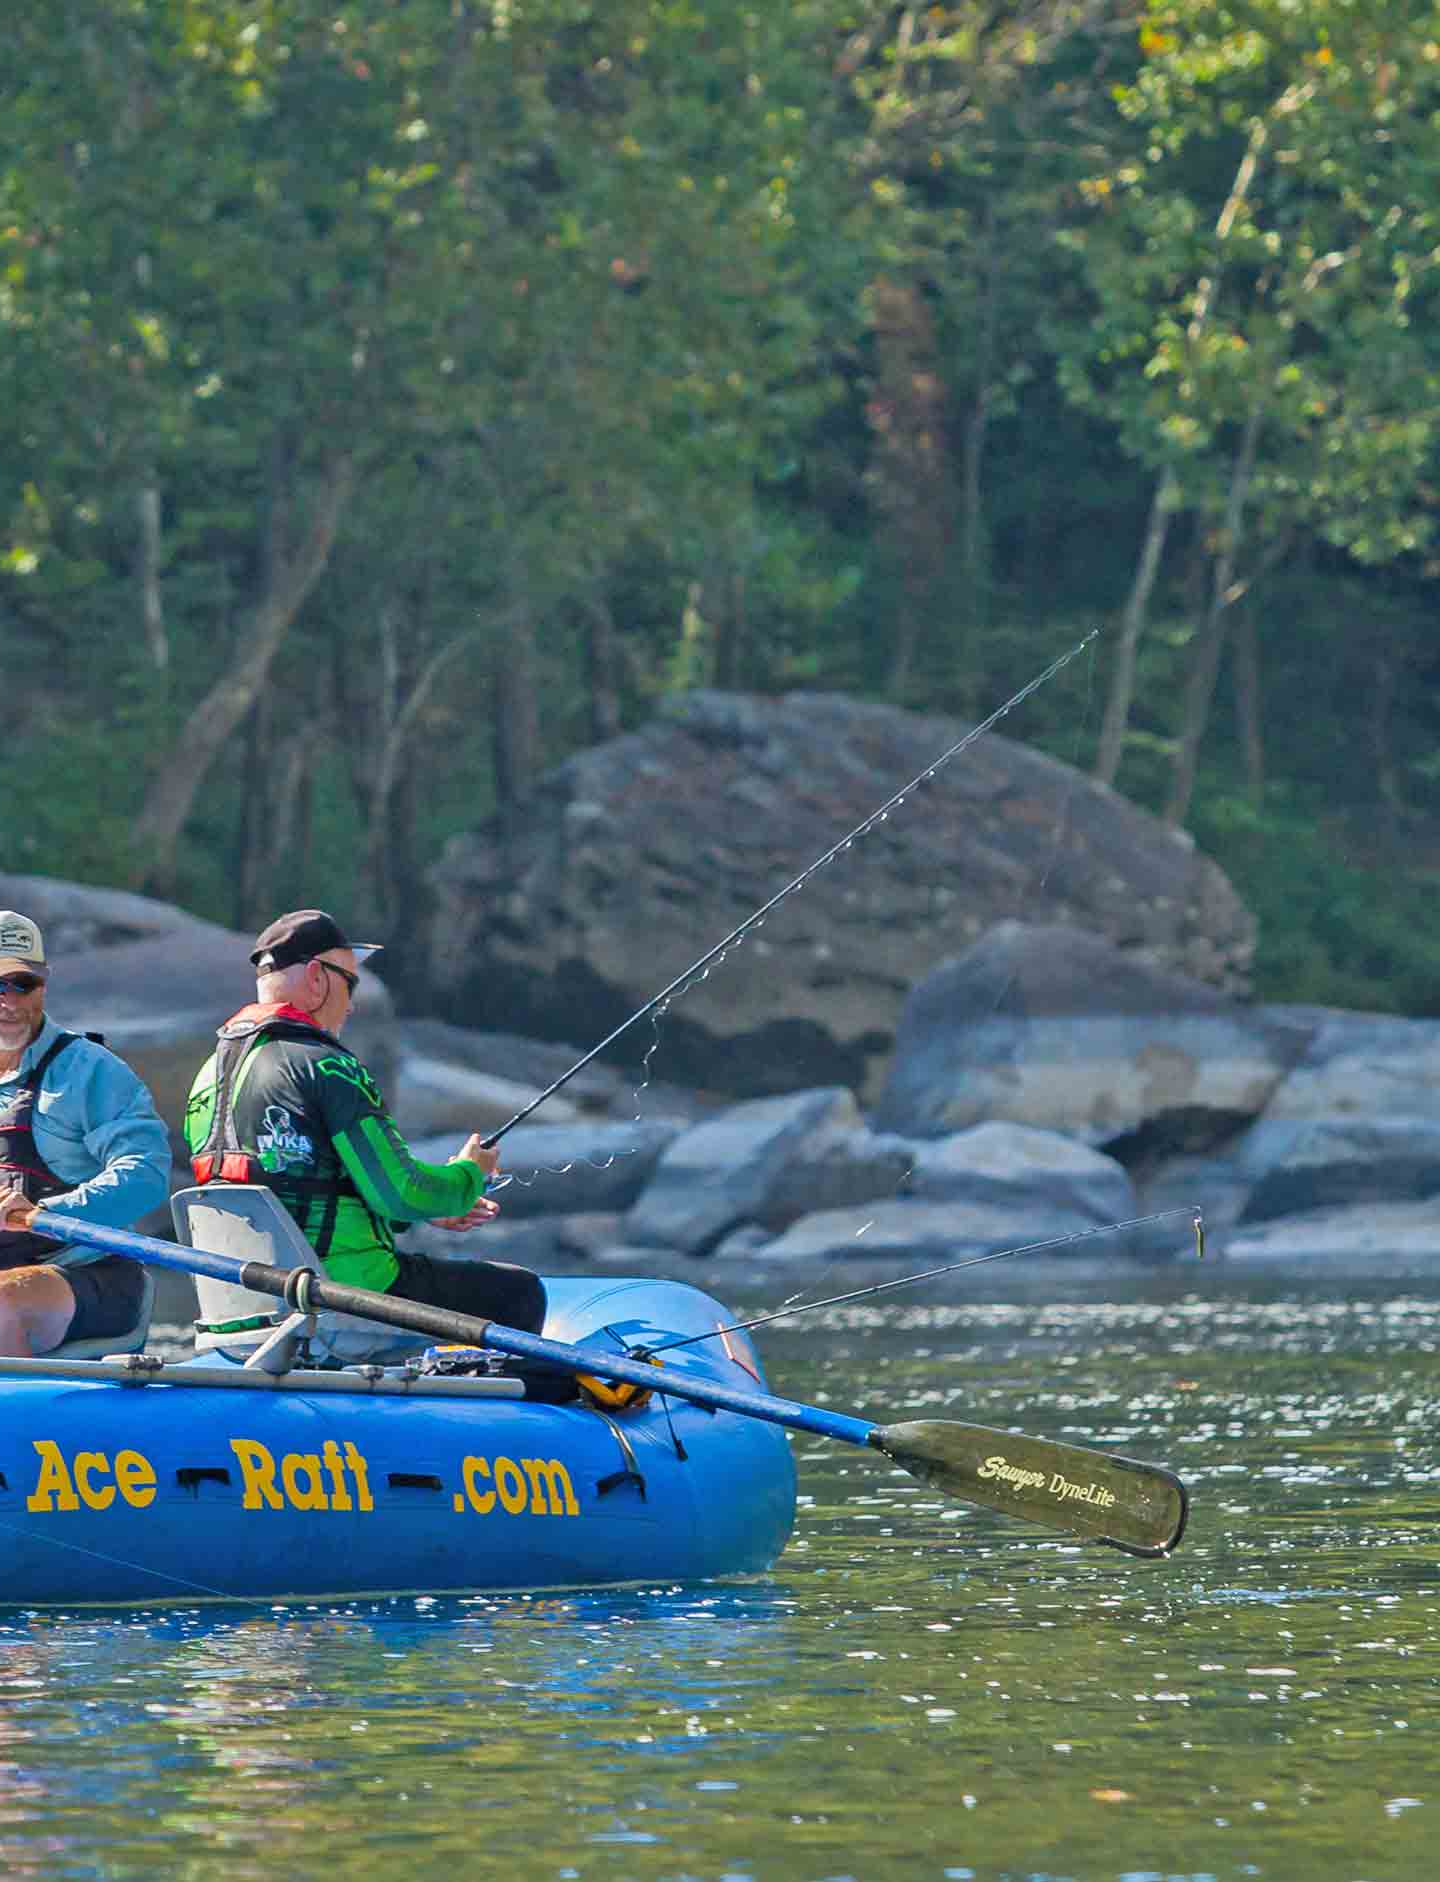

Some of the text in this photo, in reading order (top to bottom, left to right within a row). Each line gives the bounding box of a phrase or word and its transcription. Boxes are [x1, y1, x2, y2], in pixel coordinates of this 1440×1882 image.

[27, 1438, 580, 1515] Ace Raft .com
[977, 1456, 1116, 1508] Sawyer DyneLite
